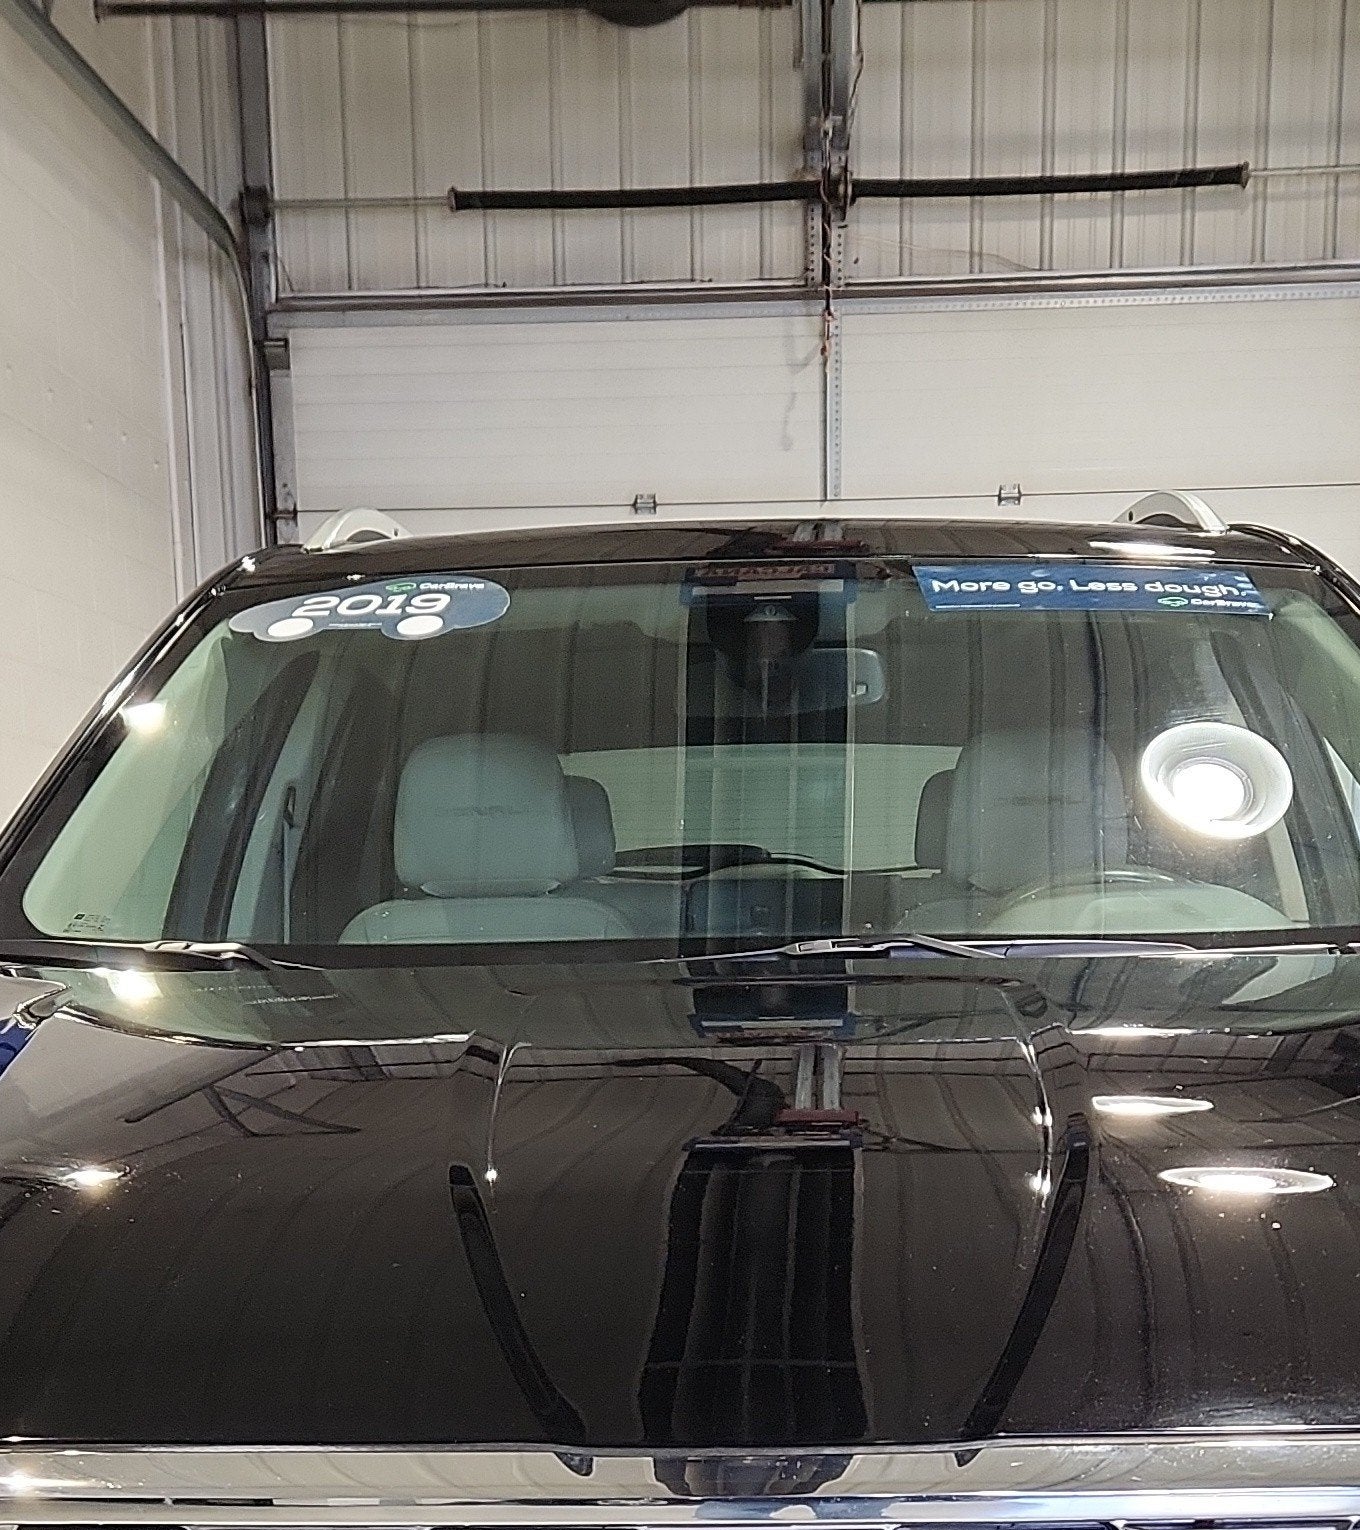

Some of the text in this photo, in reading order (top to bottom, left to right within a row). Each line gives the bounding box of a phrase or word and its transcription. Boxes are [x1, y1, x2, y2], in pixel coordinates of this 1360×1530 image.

[931, 579, 1247, 597] More go. Less dough.
[291, 593, 451, 617] 2019
